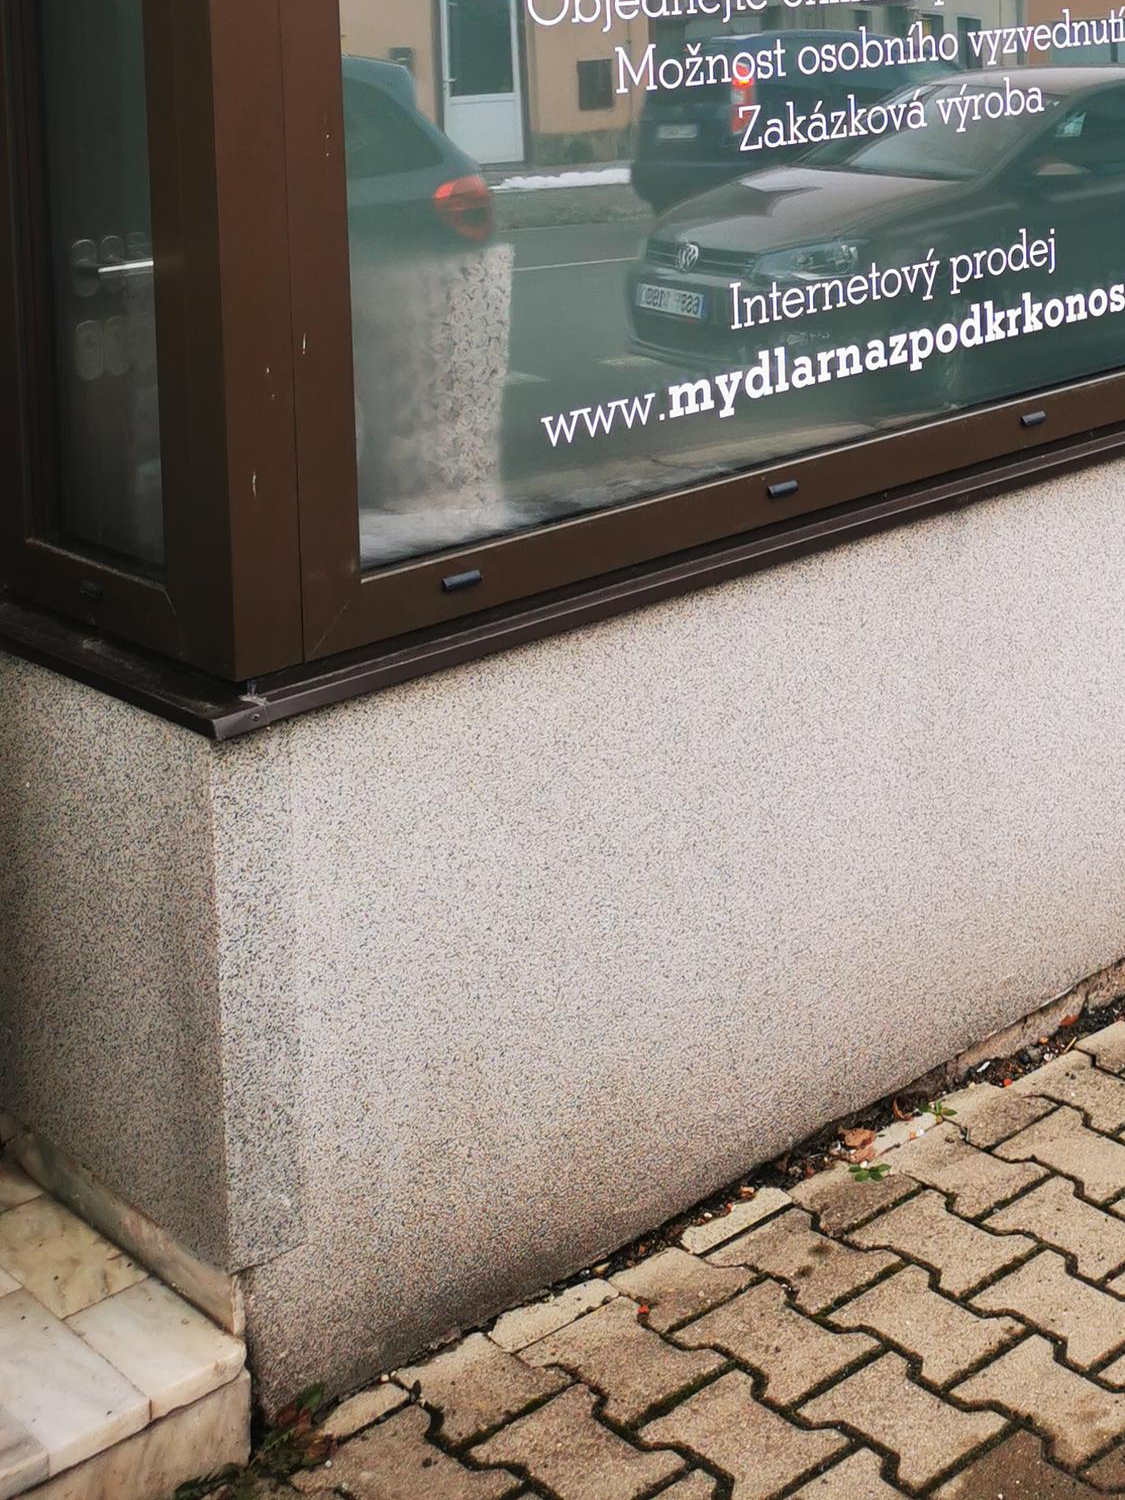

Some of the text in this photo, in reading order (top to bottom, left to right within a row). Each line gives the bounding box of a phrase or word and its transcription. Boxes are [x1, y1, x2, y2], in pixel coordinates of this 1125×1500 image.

[615, 6, 1125, 94] Možnost osobního vyzvednutí
[738, 77, 1044, 151] Zakázková výroba
[729, 248, 938, 330] Internetový
[949, 228, 1057, 280] prodej
